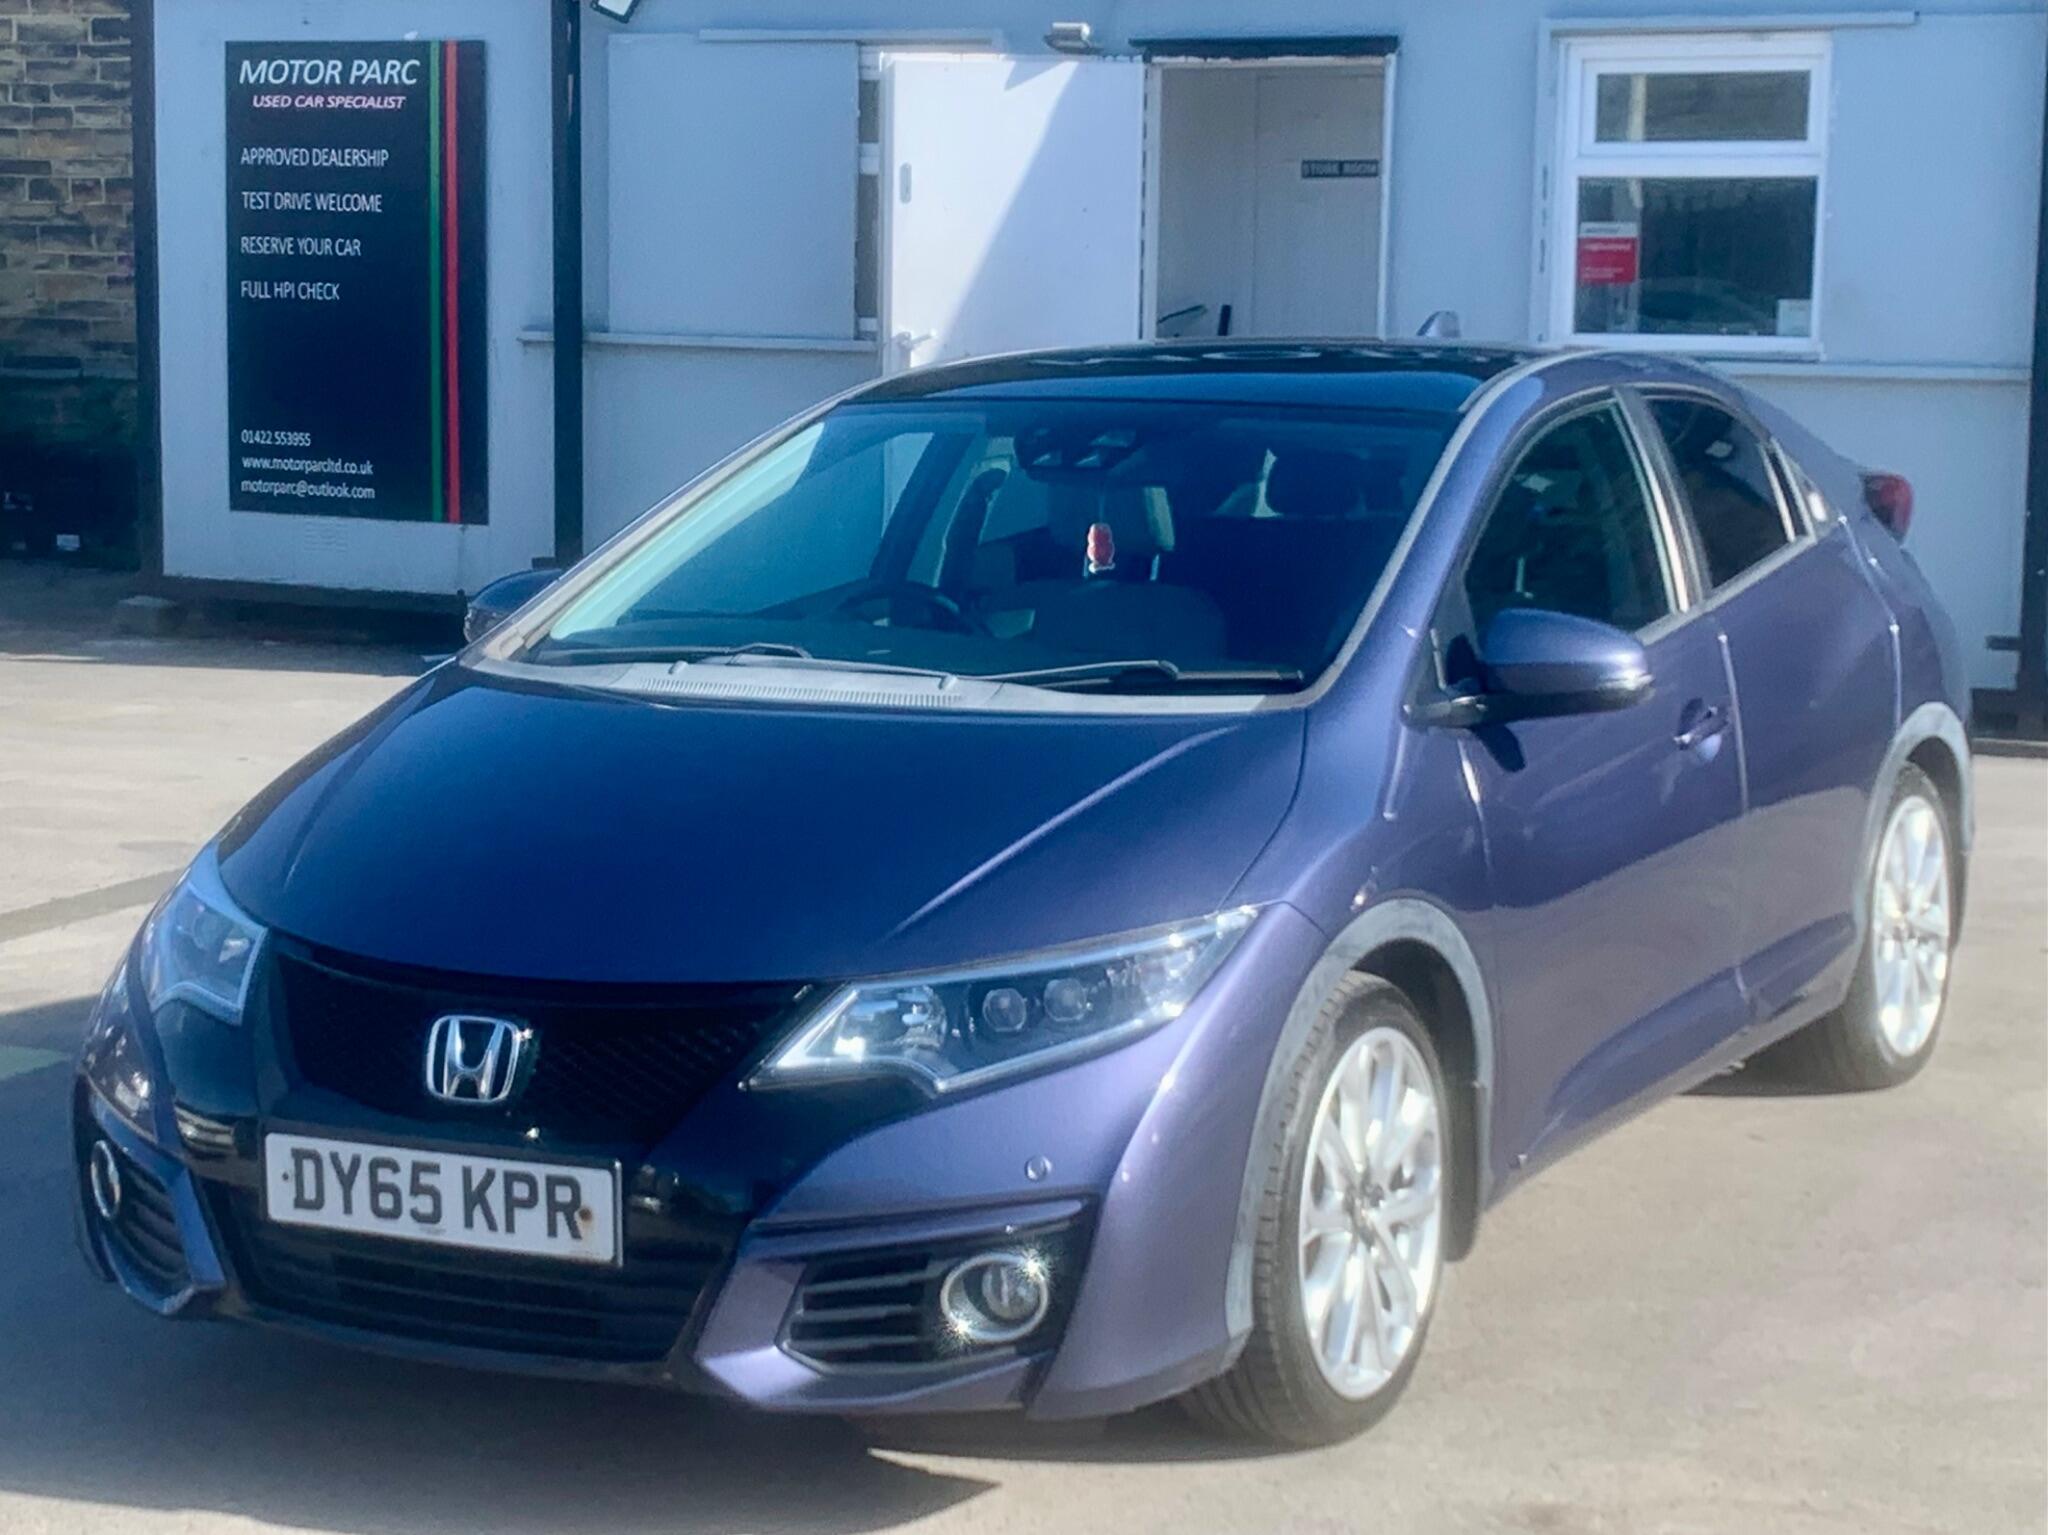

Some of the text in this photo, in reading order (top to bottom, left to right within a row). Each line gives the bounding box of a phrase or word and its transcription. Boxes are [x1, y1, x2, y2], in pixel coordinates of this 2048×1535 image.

[239, 59, 420, 86] MOTOR PARC
[252, 95, 406, 110] USED CAR SPECIALIST
[240, 147, 389, 168] APPROVED DEALERSHIP
[241, 191, 383, 213] TEST DRIVE WELCOME
[240, 236, 361, 257] RESERVE YOUR CAR
[240, 280, 340, 301] FULL HPI CHECK
[240, 429, 311, 447] 01422 553955
[241, 456, 373, 475] www.motorparcltd.co.uk
[240, 479, 376, 499] motorparc@outlook.com
[290, 1147, 583, 1240] DY65 KPR
